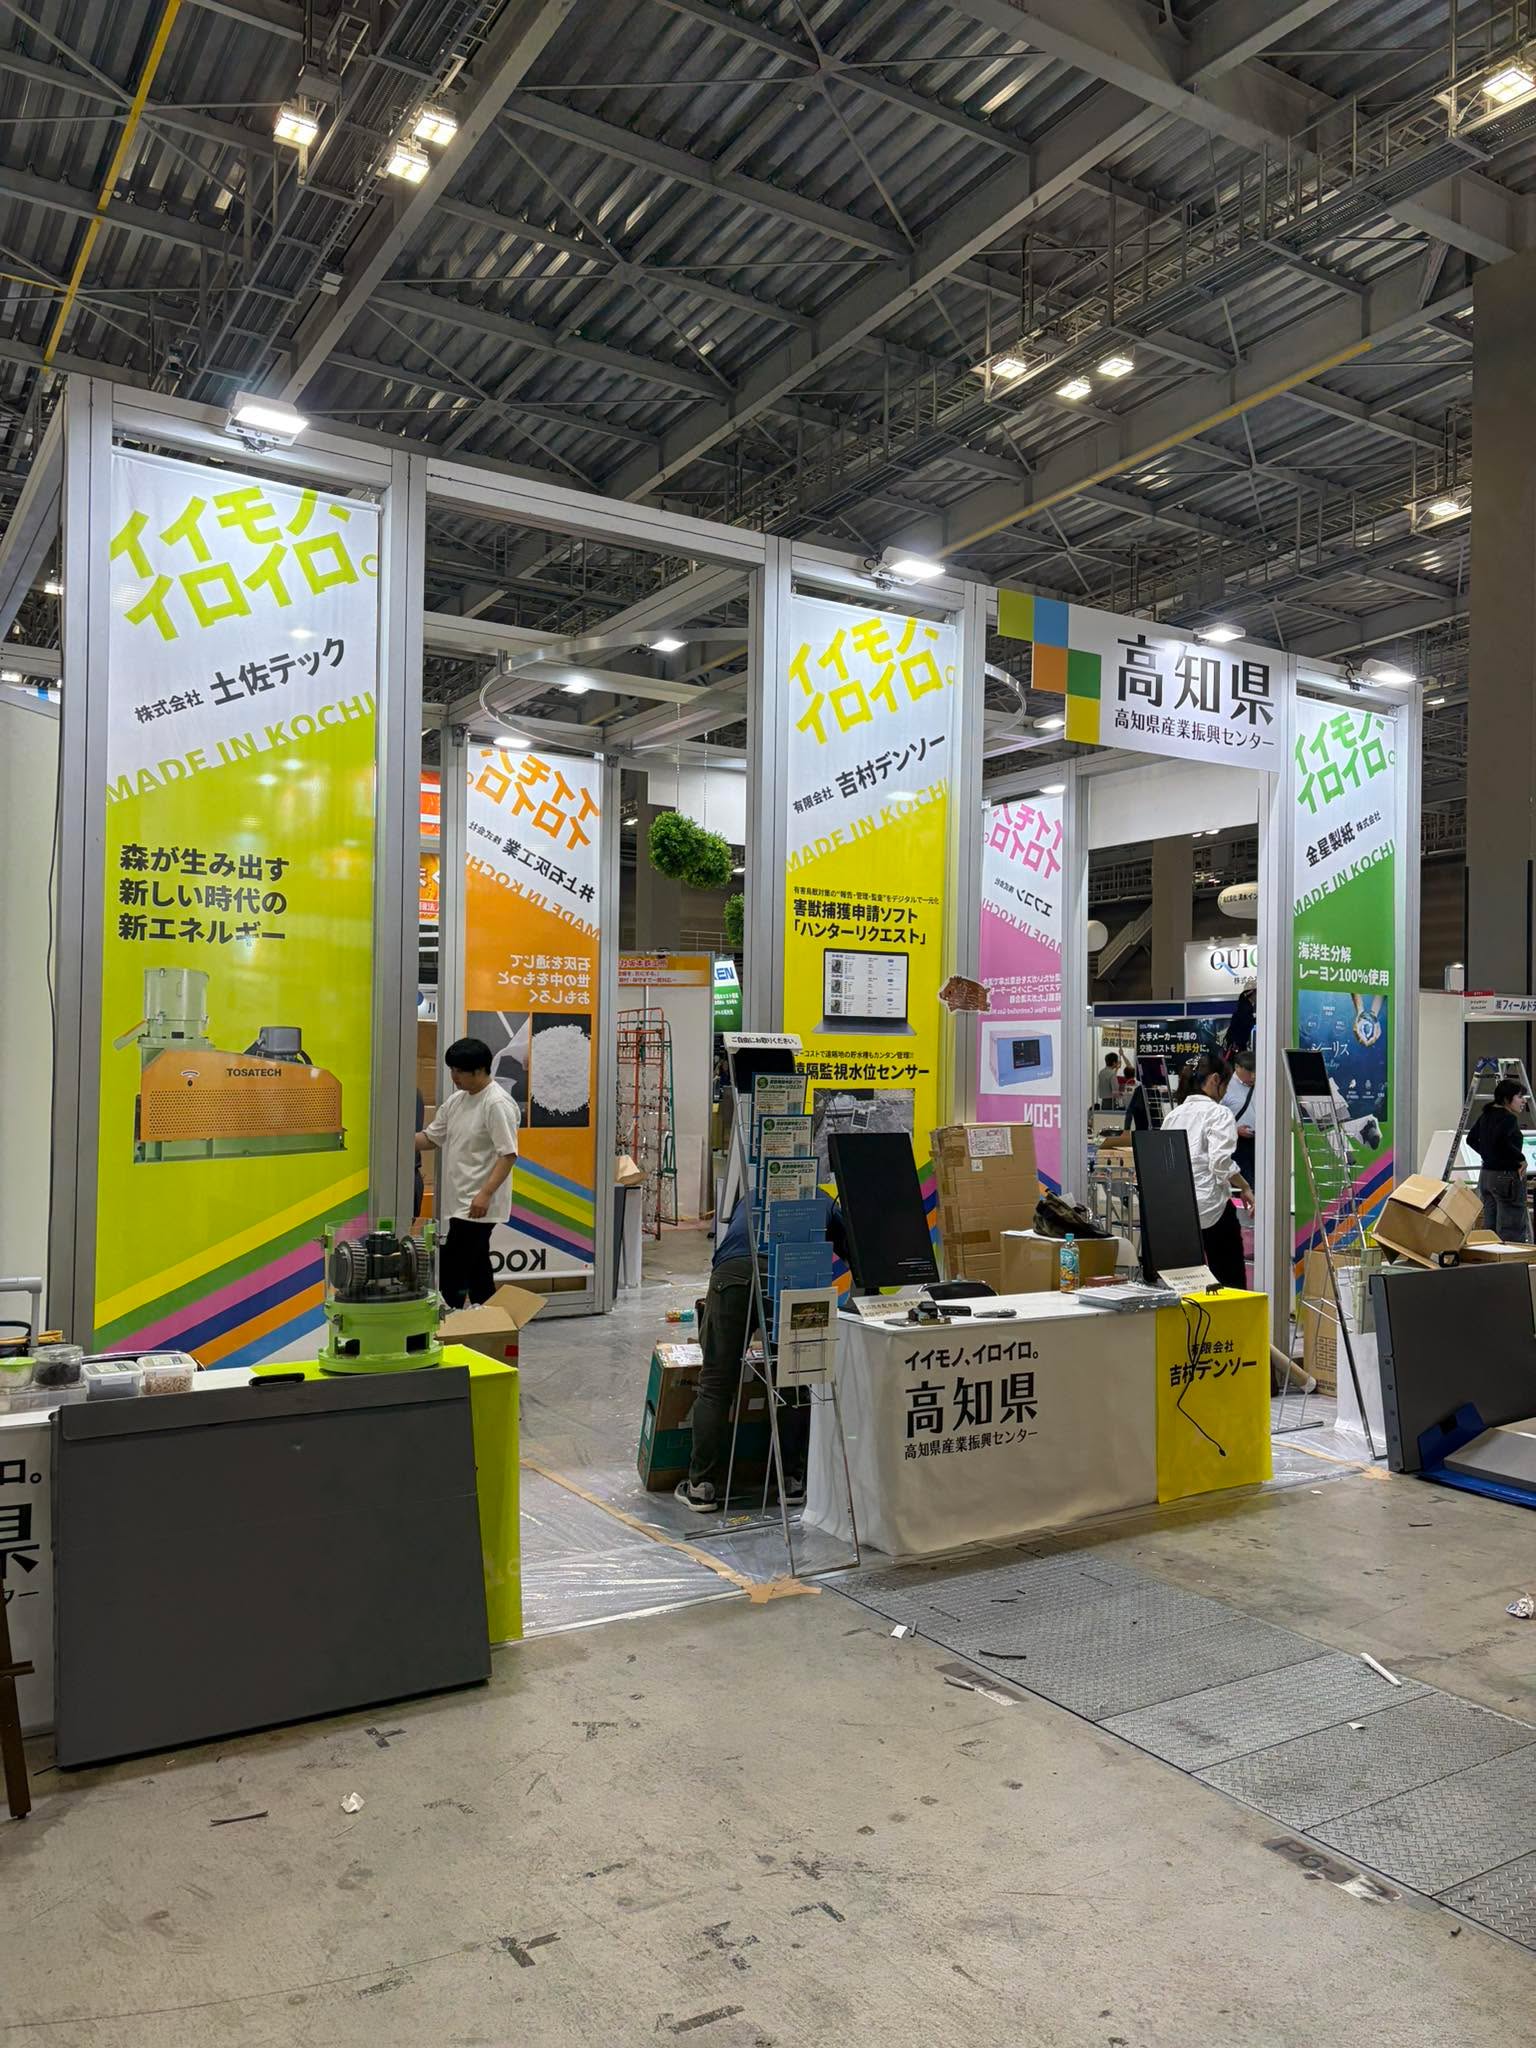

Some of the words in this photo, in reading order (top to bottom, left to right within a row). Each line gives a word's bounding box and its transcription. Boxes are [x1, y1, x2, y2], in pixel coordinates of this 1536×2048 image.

[134, 689, 204, 723] 株式会社
[209, 637, 346, 706] 土佐テック
[1117, 634, 1274, 726] 高知県
[1114, 707, 1275, 750] 高知県産業振興センター
[106, 747, 209, 804] MADE
[217, 731, 259, 772] IN
[265, 691, 376, 752] KOCHI
[792, 786, 835, 814] 有限会社
[835, 734, 946, 799] 吉村デンソー
[847, 816, 876, 843] IN
[1306, 822, 1356, 868] 金星製紙
[1356, 810, 1381, 832] 株式会社
[119, 844, 290, 882] 森が生み出す
[1333, 869, 1348, 892] IN
[118, 878, 288, 916] 新しい時代の
[793, 899, 918, 923] 害獣捕獲申請ソフト
[118, 913, 286, 946] 新エネルギー
[794, 919, 926, 945] 「ハンターリクエスト」
[1298, 941, 1352, 963] 海洋生分解
[714, 967, 735, 980] EN
[1298, 963, 1390, 986] レーヨン100%使用
[226, 1067, 282, 1078] TOSATECH
[904, 1341, 1041, 1372] イイモノ、イロイロ。
[1169, 1358, 1257, 1387] 吉村デンソー
[905, 1372, 1038, 1438] 高知県
[904, 1429, 1038, 1460] 高知県産業振興センター
